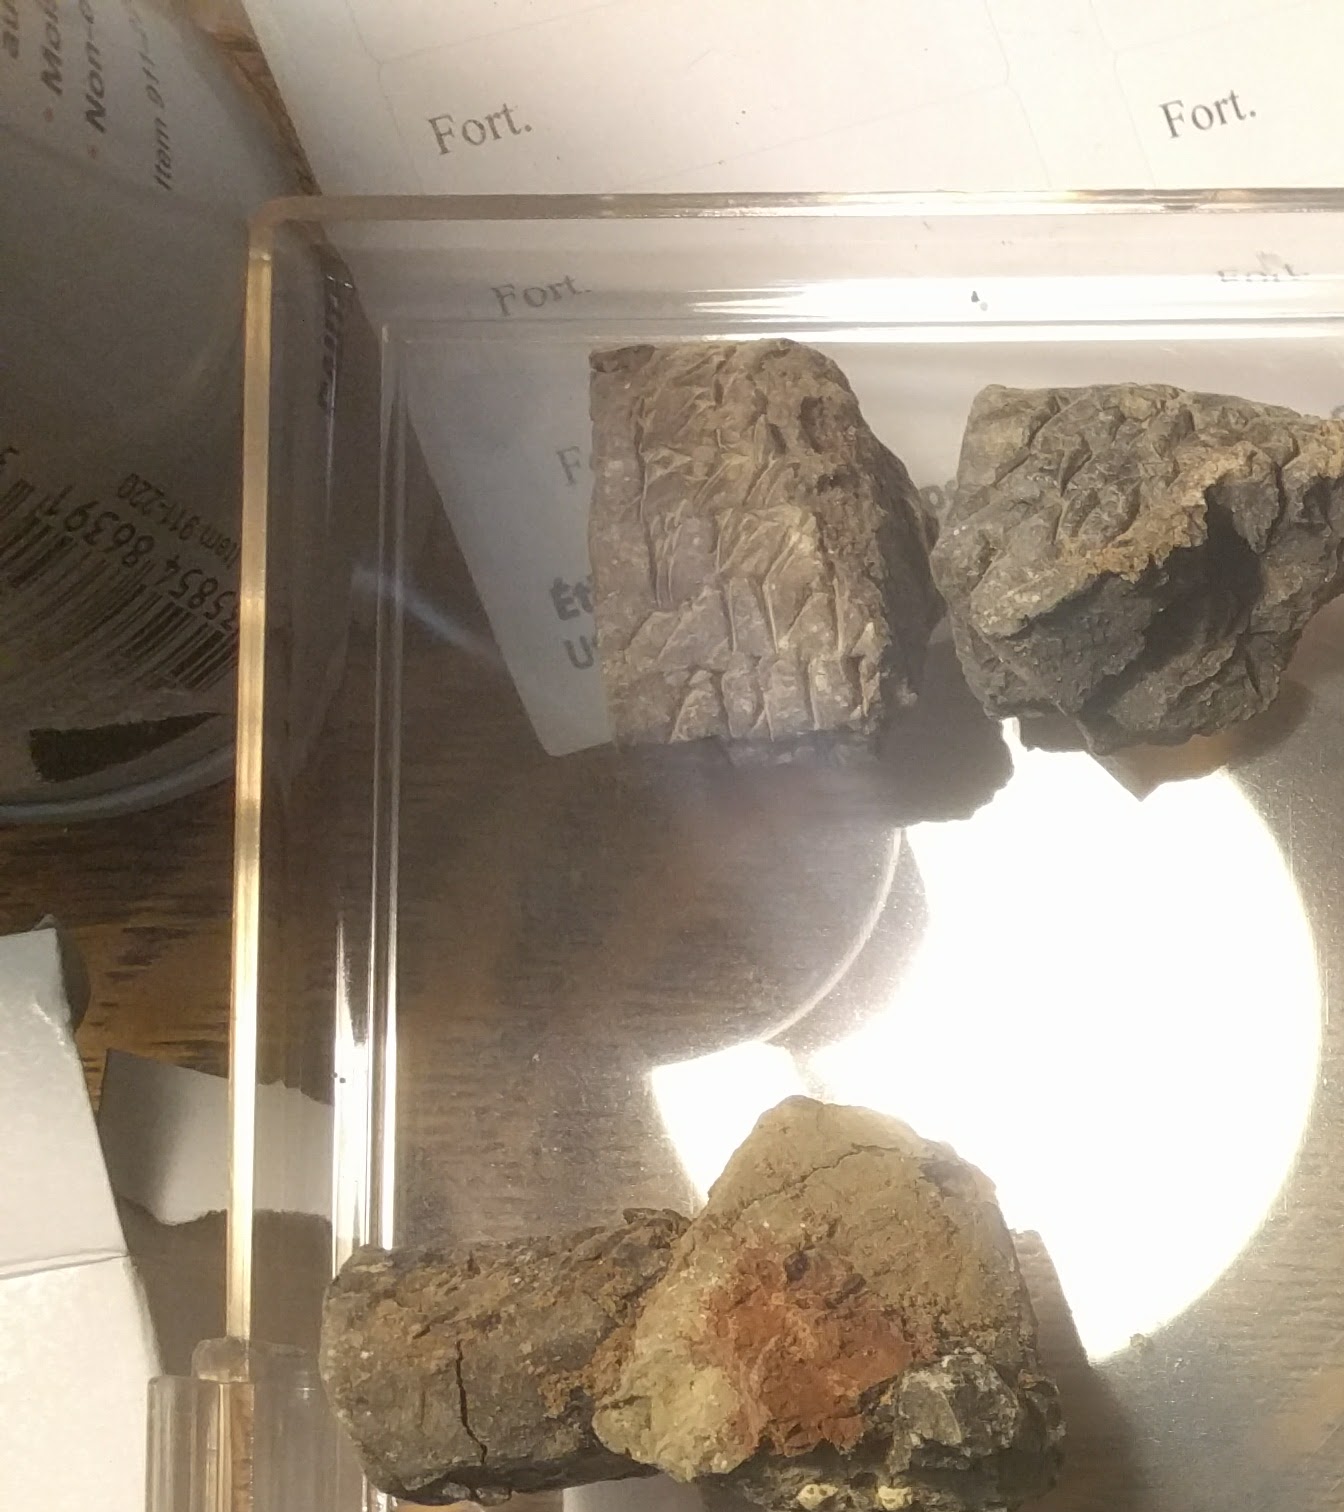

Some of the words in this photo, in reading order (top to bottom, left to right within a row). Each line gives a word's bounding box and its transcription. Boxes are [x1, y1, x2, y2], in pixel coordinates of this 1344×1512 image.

[427, 102, 533, 155] Fort.
[1158, 89, 1258, 139] Fort.
[153, 117, 173, 191] Item
[490, 274, 593, 318] Fort.
